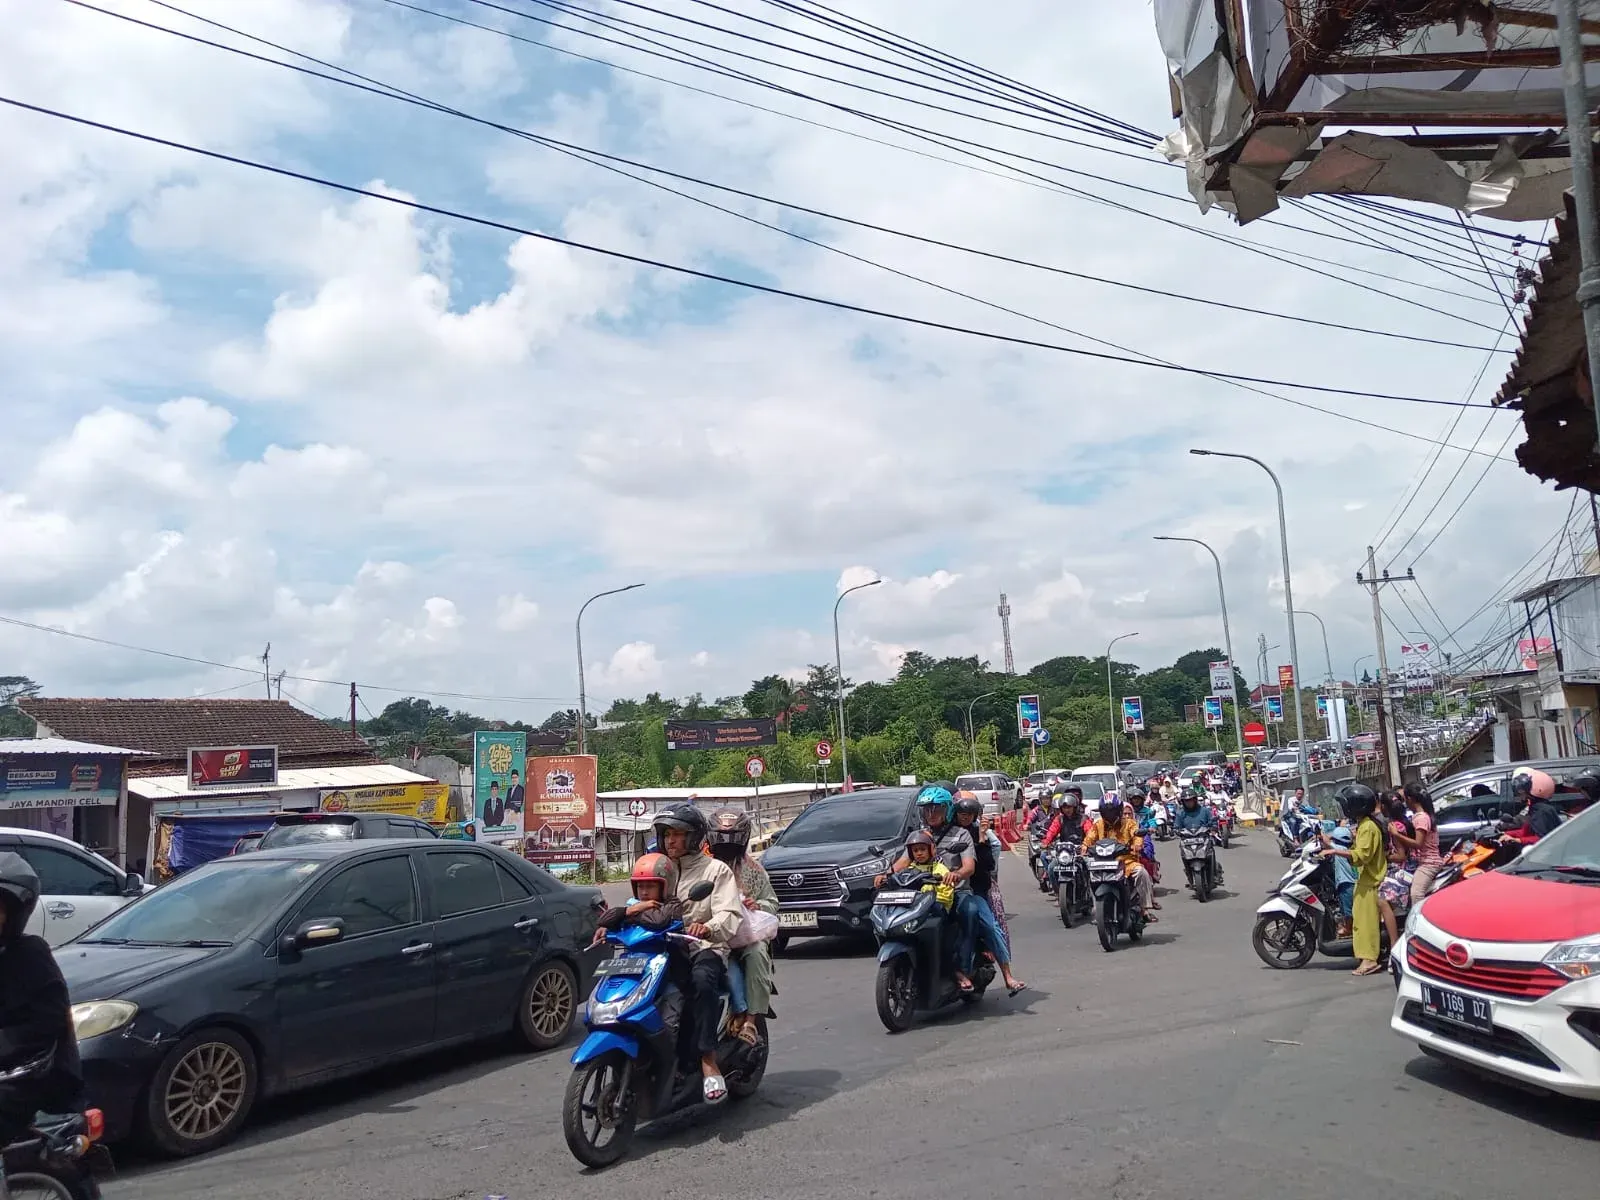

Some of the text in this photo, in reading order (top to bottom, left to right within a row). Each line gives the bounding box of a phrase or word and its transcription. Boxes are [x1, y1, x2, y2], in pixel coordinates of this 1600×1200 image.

[819, 743, 829, 755] S
[9, 797, 102, 809] JAYA MANDIRI CELL
[1424, 987, 1488, 1020] N 1169 DZ
